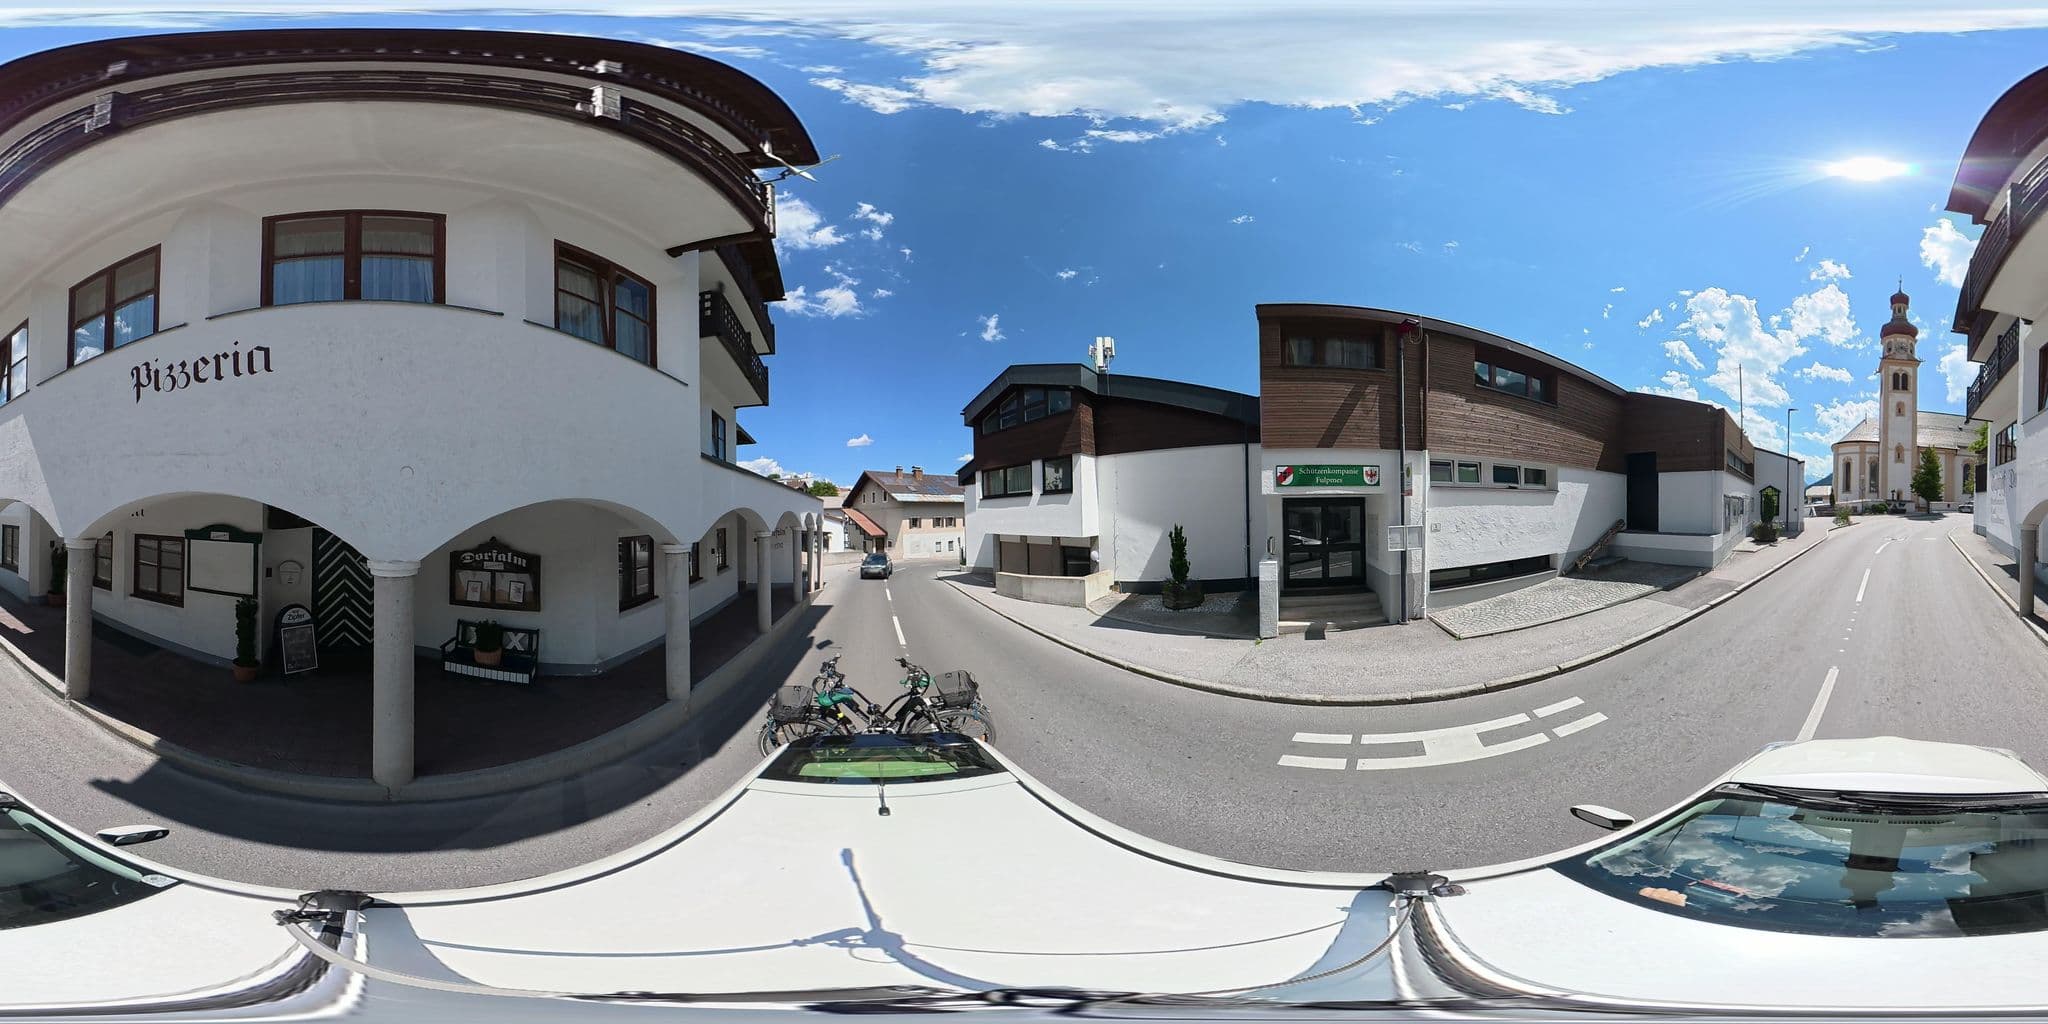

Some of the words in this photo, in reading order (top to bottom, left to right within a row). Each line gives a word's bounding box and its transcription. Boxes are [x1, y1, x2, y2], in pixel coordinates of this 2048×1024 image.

[131, 341, 274, 404] Pizzeria
[1298, 467, 1359, 477] Schützenkompanie
[1315, 476, 1343, 486] Fulpmes
[461, 549, 527, 568] Dorfalm
